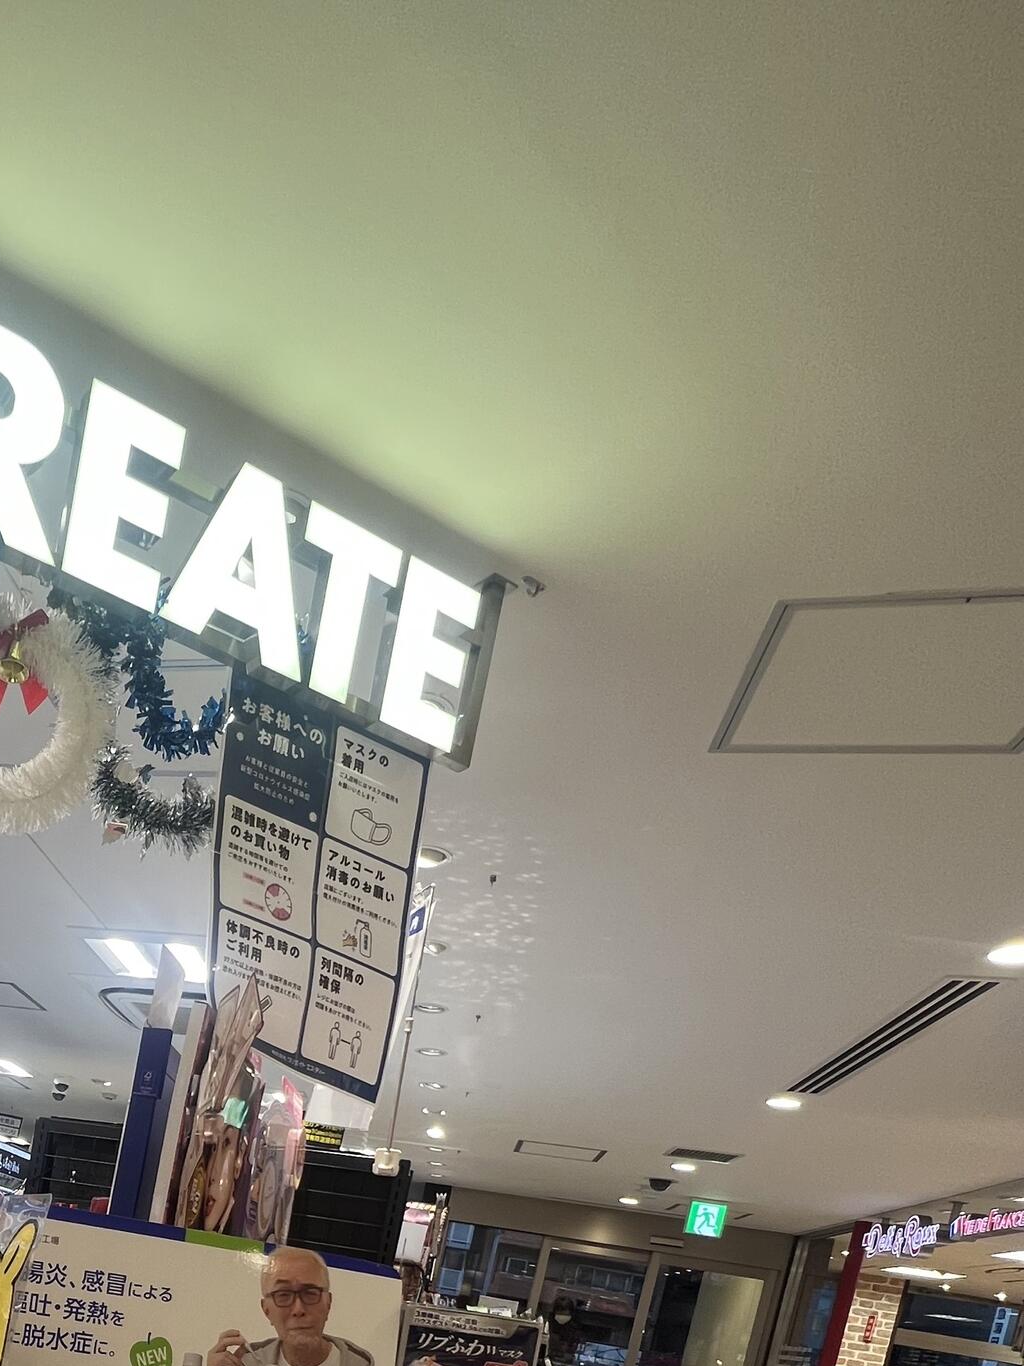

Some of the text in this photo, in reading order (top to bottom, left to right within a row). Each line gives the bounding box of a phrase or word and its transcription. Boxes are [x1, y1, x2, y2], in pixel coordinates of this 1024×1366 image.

[242, 697, 323, 745] お客様への
[257, 729, 305, 759] お願い
[343, 738, 389, 768] マスクの
[341, 752, 365, 775] 着用
[231, 805, 312, 850] 混雑時を避けて
[230, 825, 290, 861] のお買い物
[328, 849, 386, 882] アルコール
[325, 864, 395, 902] 消毒のお願い
[226, 919, 300, 959] 体調不良時の
[226, 938, 262, 963] ご利用
[319, 974, 341, 995] 確保
[321, 956, 364, 986] 列間隔の
[418, 1333, 524, 1360] リブふわ マスク
